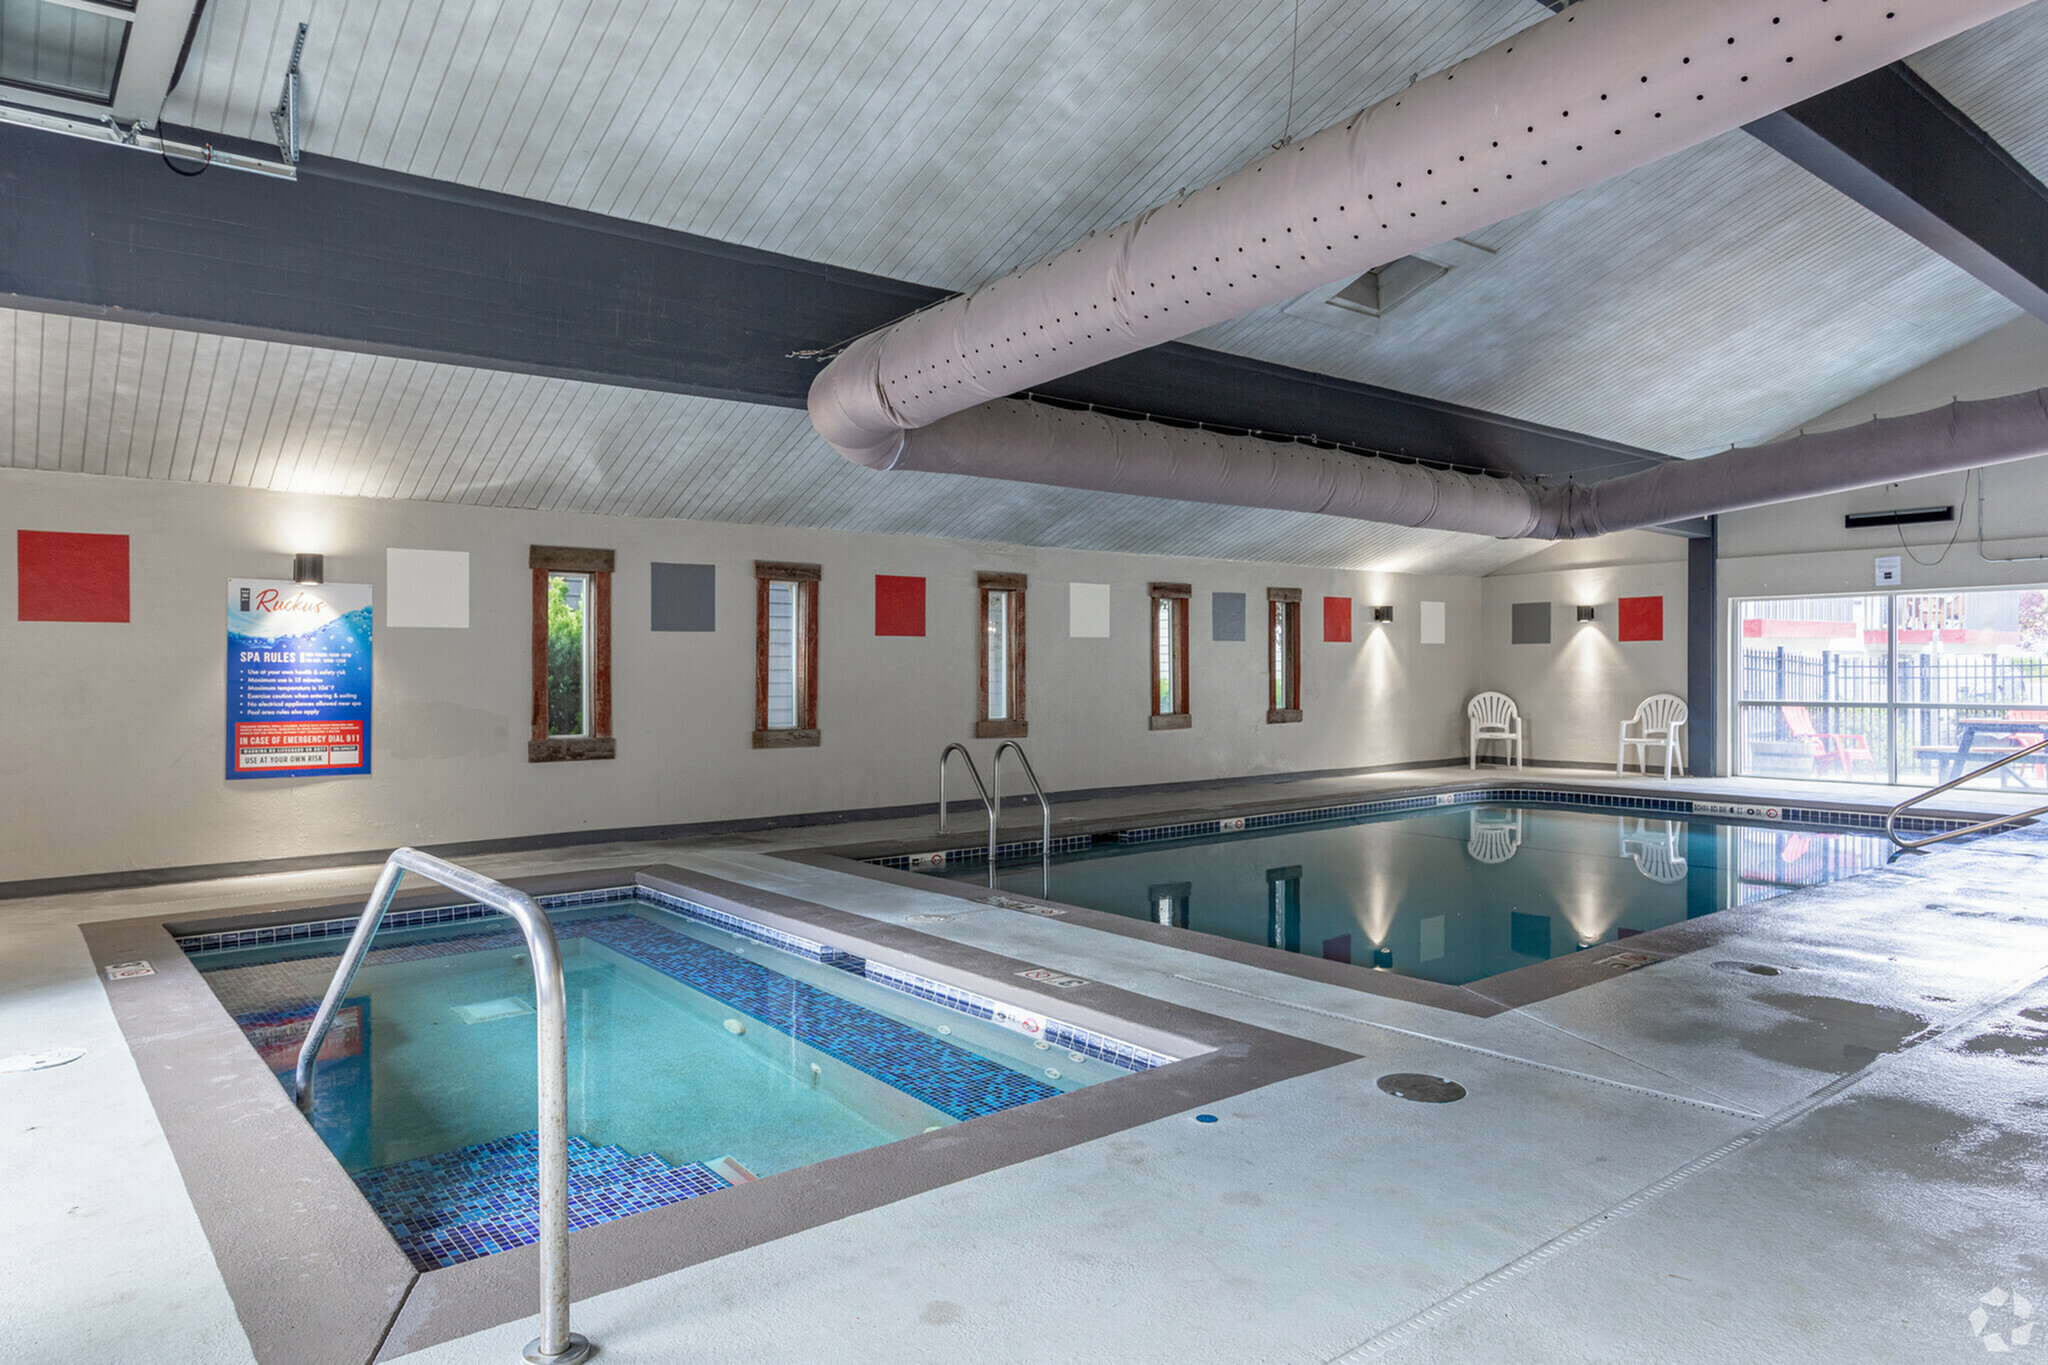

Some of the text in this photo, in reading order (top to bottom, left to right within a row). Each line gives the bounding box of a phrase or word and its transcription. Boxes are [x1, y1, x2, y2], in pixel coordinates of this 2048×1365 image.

[256, 589, 328, 613] Ruckus
[240, 651, 260, 663] SPA
[264, 652, 296, 663] RULES
[240, 737, 248, 745] IN
[250, 736, 270, 745] CASE
[271, 736, 281, 744] OF
[283, 735, 326, 744] EMERGENCY
[346, 734, 360, 742] 911
[290, 755, 306, 763] OWN
